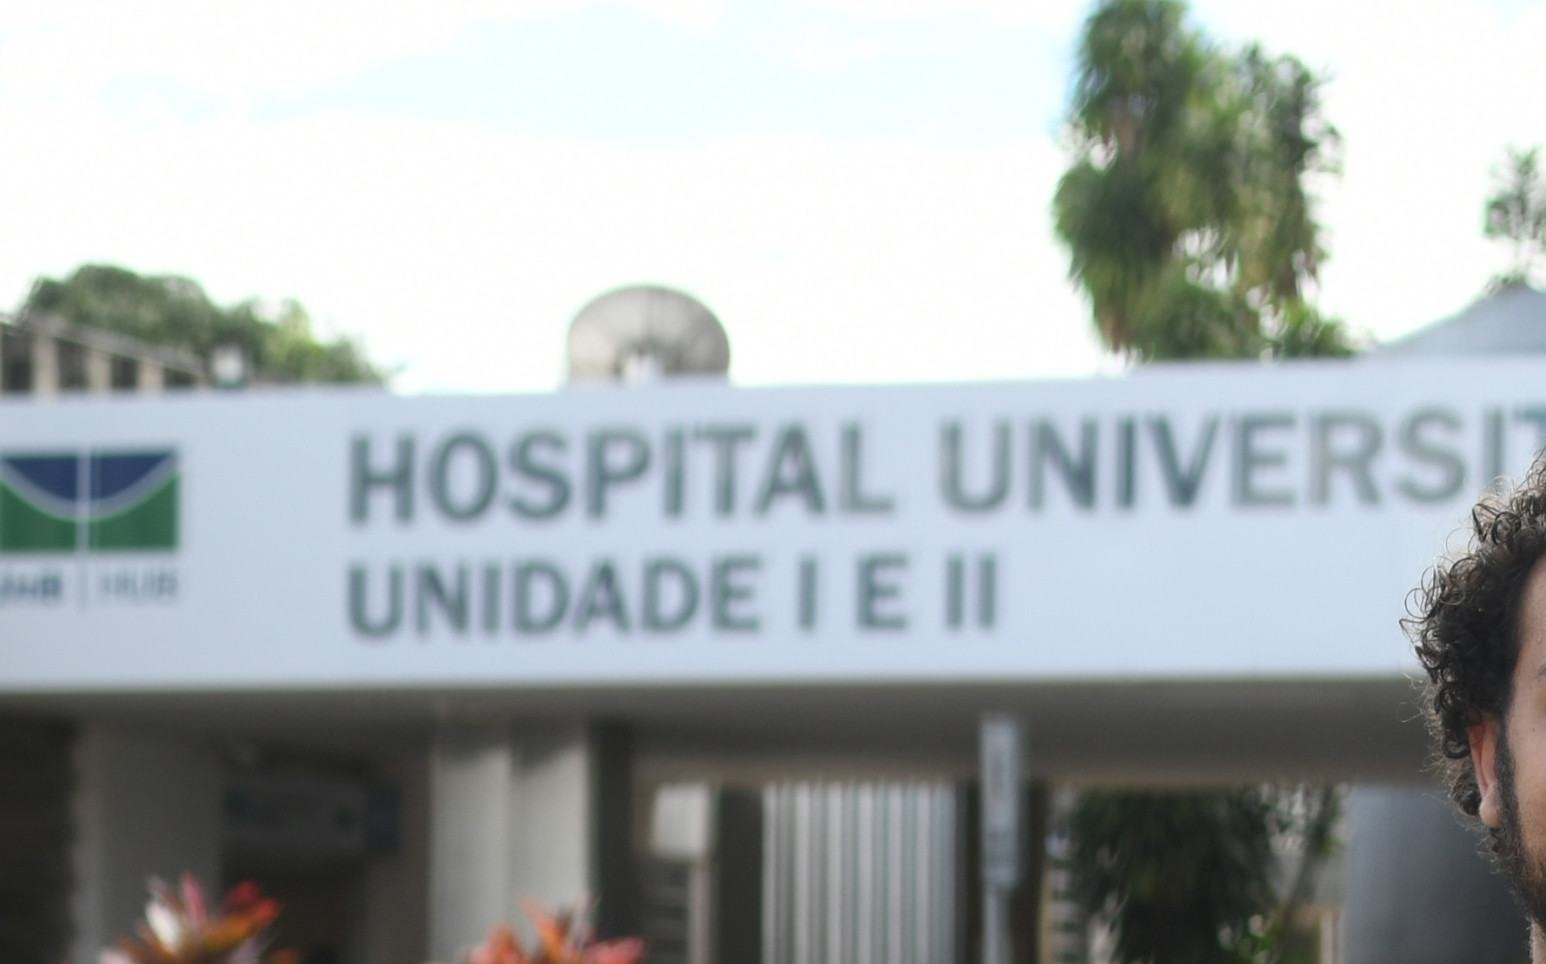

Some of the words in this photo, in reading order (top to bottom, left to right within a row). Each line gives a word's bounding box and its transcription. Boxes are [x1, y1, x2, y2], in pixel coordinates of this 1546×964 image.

[348, 422, 894, 525] HOSPITAL
[348, 553, 761, 638] UNIDADE
[799, 554, 816, 632] I
[857, 552, 908, 632] E
[945, 550, 996, 631] II
